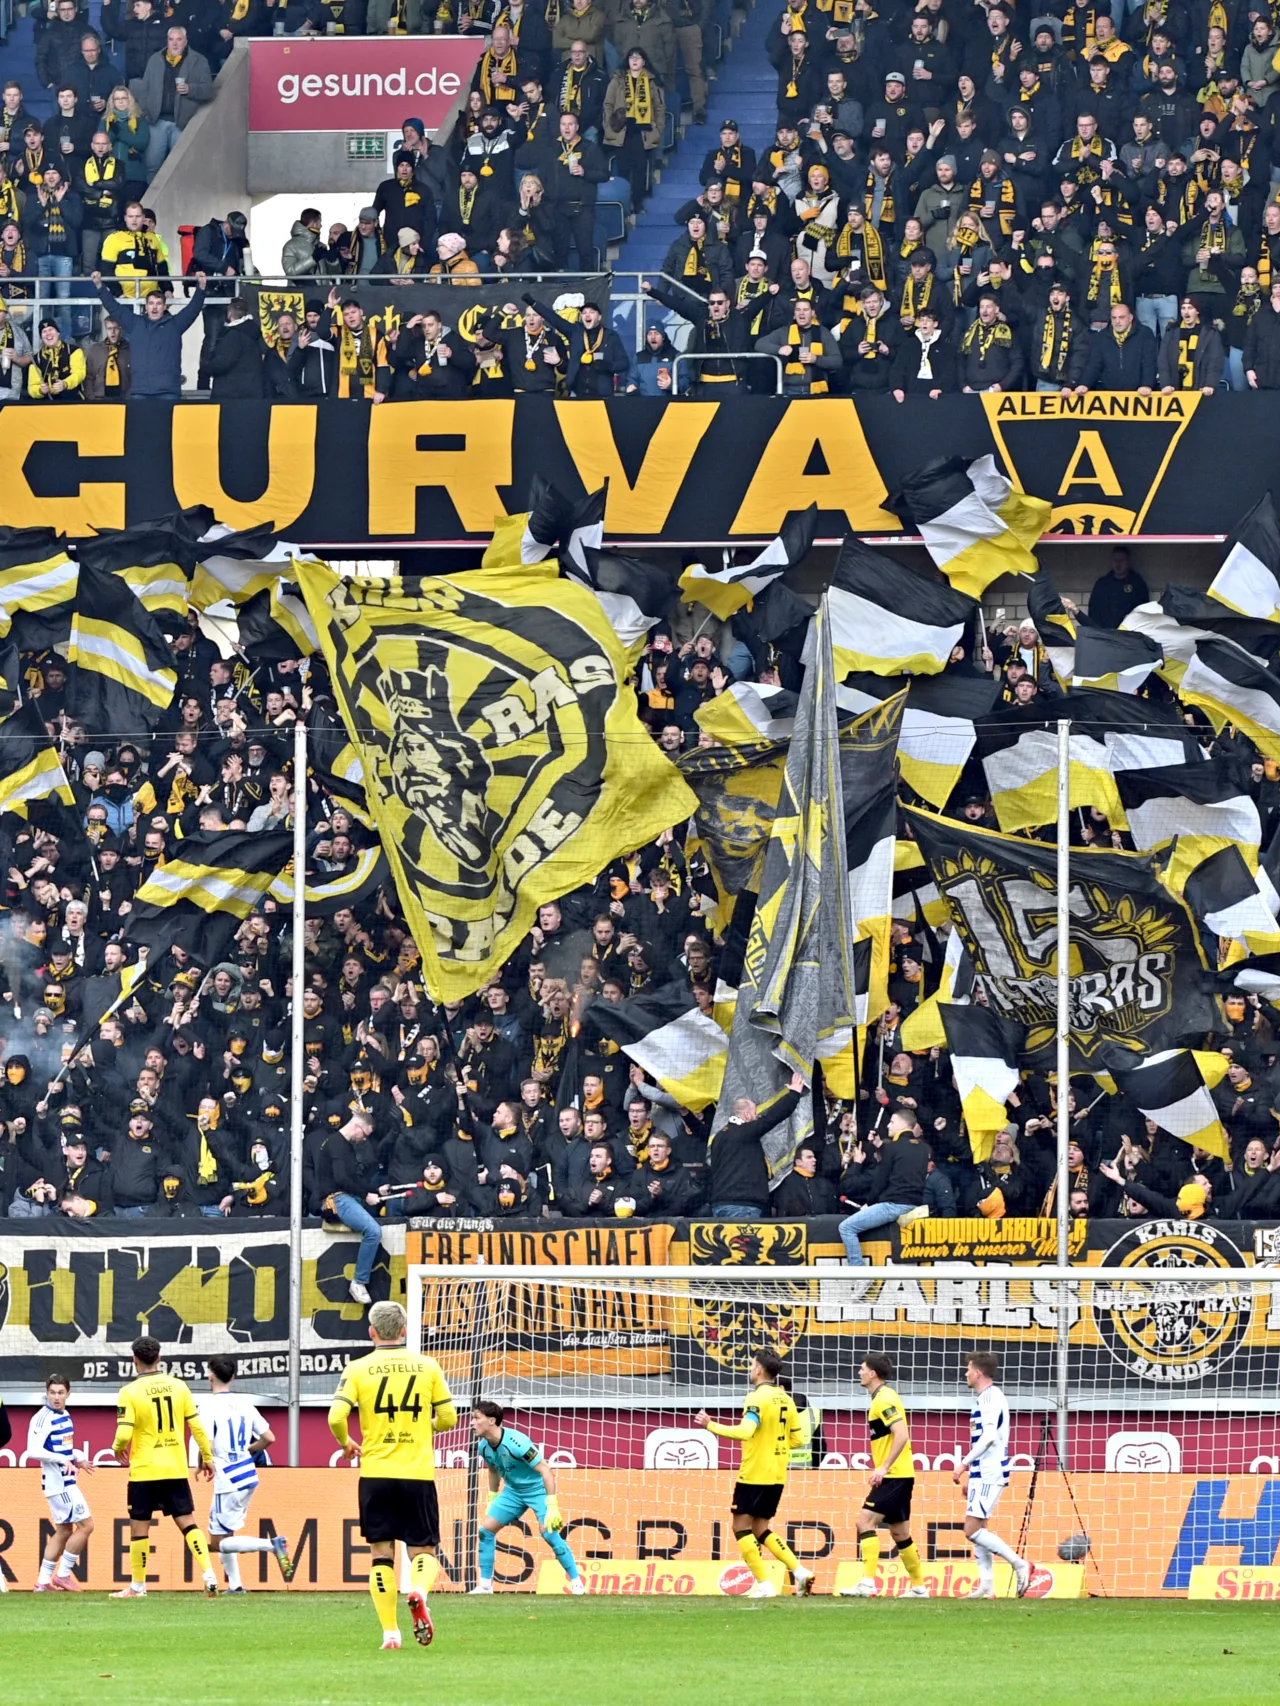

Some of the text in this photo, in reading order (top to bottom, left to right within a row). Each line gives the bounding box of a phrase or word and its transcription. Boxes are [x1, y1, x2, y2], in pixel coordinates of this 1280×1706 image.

[277, 67, 460, 104] gesund.de
[996, 396, 1185, 418] ALEMANNIA
[0, 399, 902, 537] CURVA
[1058, 430, 1122, 497] A
[420, 1228, 652, 1266] FREUNDSCHAFT
[1135, 1222, 1217, 1245] KARLS
[84, 1362, 109, 1379] DE
[368, 1363, 424, 1375] CASTELLE
[1131, 1356, 1214, 1381] BANDE
[146, 1385, 173, 1396] LOUNE
[373, 1374, 422, 1423] 44
[151, 1395, 175, 1433] 11
[777, 1406, 788, 1441] 5
[228, 1416, 247, 1452] 14
[562, 1561, 696, 1595] Sinalco
